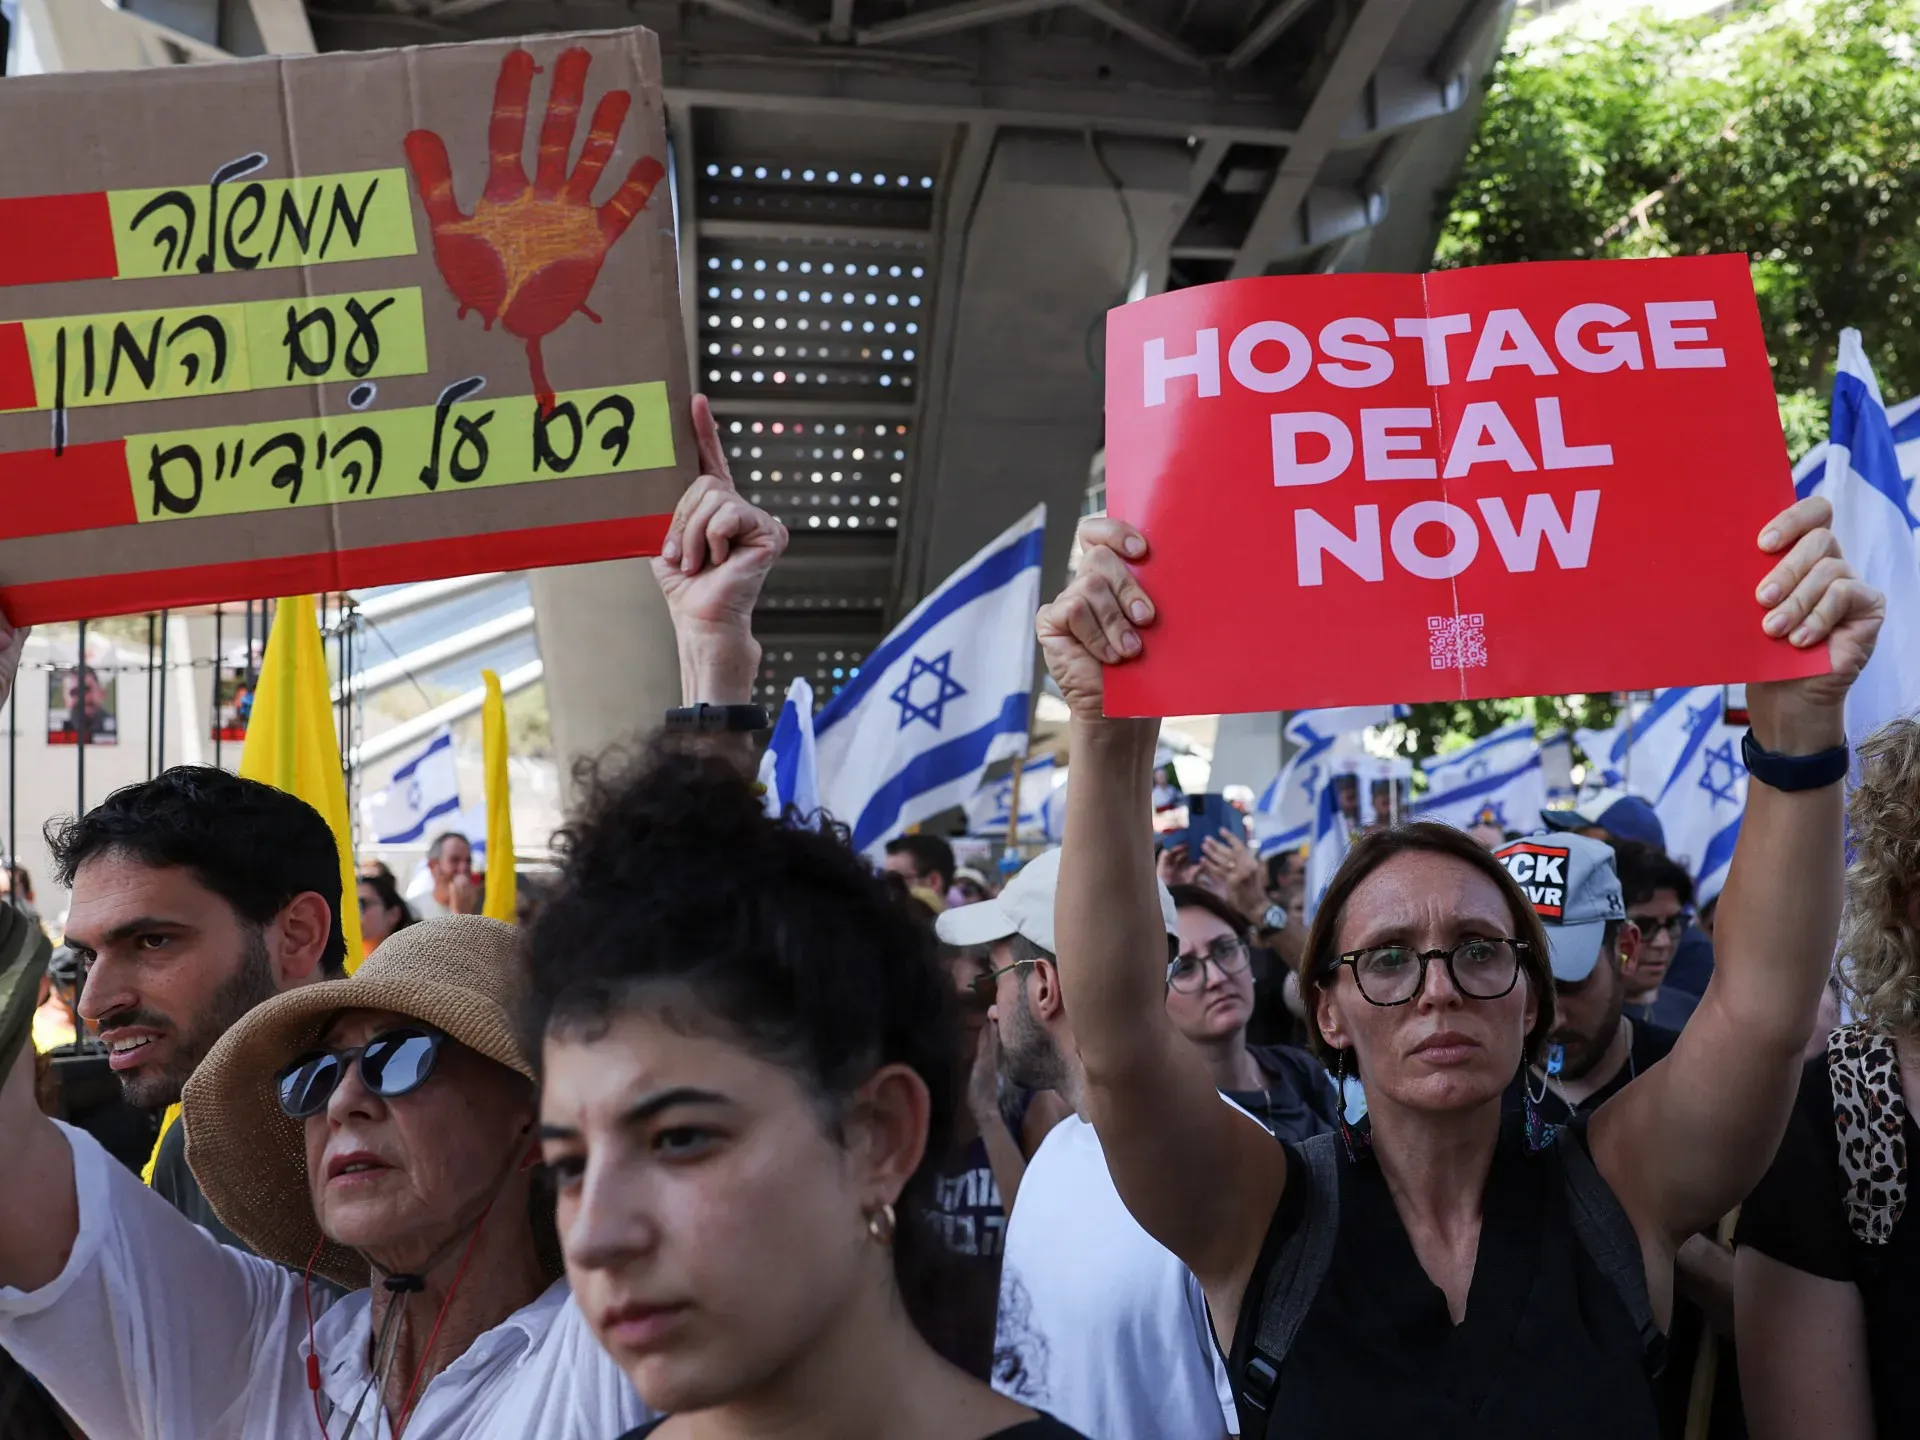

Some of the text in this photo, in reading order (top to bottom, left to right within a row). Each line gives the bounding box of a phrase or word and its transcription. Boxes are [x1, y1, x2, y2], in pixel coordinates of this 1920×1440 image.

[130, 153, 379, 274] ממשלה
[54, 314, 227, 457] המון
[1143, 300, 1727, 408] HOSTAGE
[149, 376, 635, 516] דם על הידיים
[1270, 396, 1614, 488] DEAL
[1294, 489, 1601, 587] NOW
[1499, 854, 1564, 883] CK
[1521, 887, 1562, 905] VR
